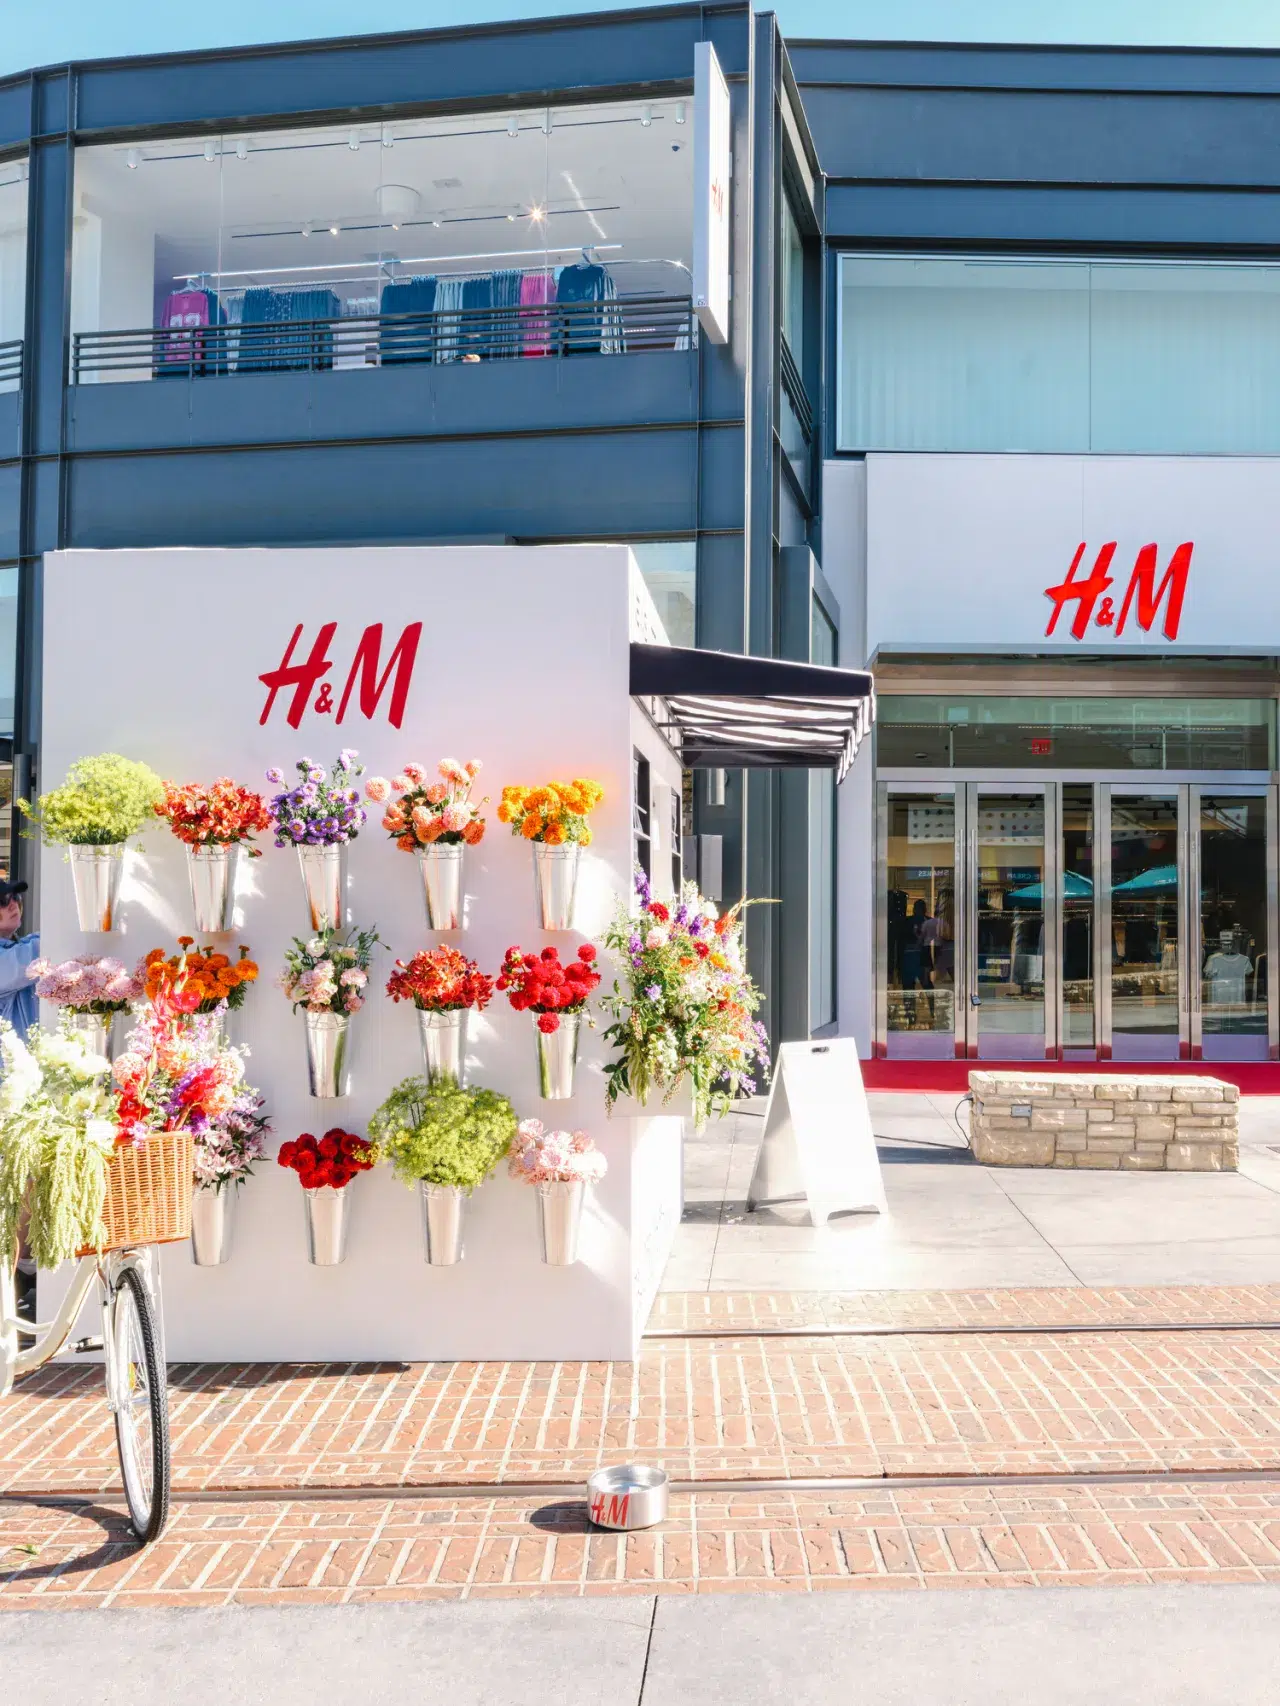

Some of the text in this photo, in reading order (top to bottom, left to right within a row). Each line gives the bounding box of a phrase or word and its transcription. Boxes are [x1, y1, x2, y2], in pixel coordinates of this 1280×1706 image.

[1044, 541, 1194, 641] H&M
[258, 622, 423, 730] H&M
[591, 1492, 630, 1527] H&M
